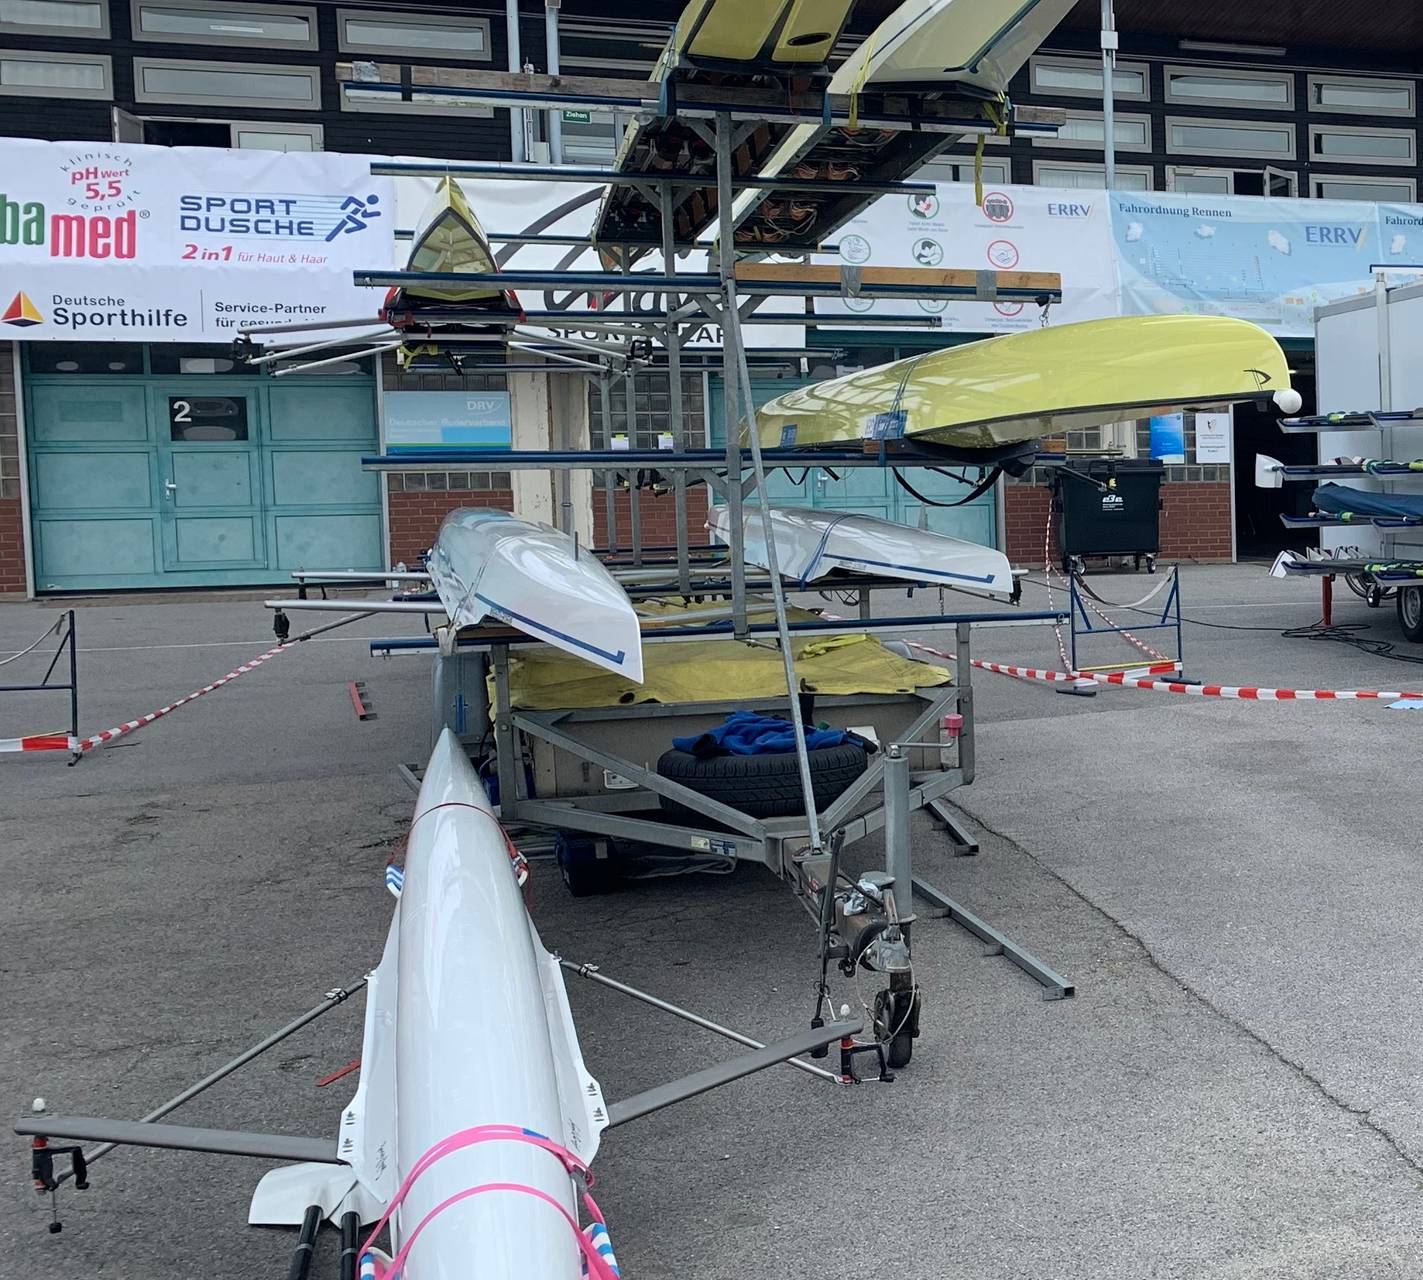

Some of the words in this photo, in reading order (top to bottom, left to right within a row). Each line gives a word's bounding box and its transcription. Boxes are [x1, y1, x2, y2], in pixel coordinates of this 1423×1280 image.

[60, 152, 133, 172] klinisch
[71, 167, 98, 184] pH
[101, 169, 129, 179] Wert
[86, 180, 122, 201] 5,5
[68, 190, 142, 212] geprüft
[180, 195, 297, 216] SPORT
[1048, 203, 1092, 217] ERRV
[1119, 203, 1190, 218] Fahrordnung
[1192, 207, 1232, 217] Rennen
[180, 215, 315, 236] DUSCHE
[1306, 226, 1363, 246] ERRV
[237, 251, 253, 263] für
[257, 253, 285, 264] Haut
[288, 254, 297, 264] &
[301, 254, 328, 265] Haar
[52, 295, 125, 307] Deutsche
[215, 301, 327, 314] Service-Partner
[53, 308, 188, 330] Sporthilfe
[215, 316, 235, 328] für
[172, 400, 192, 423] 2
[467, 401, 495, 411] DRV
